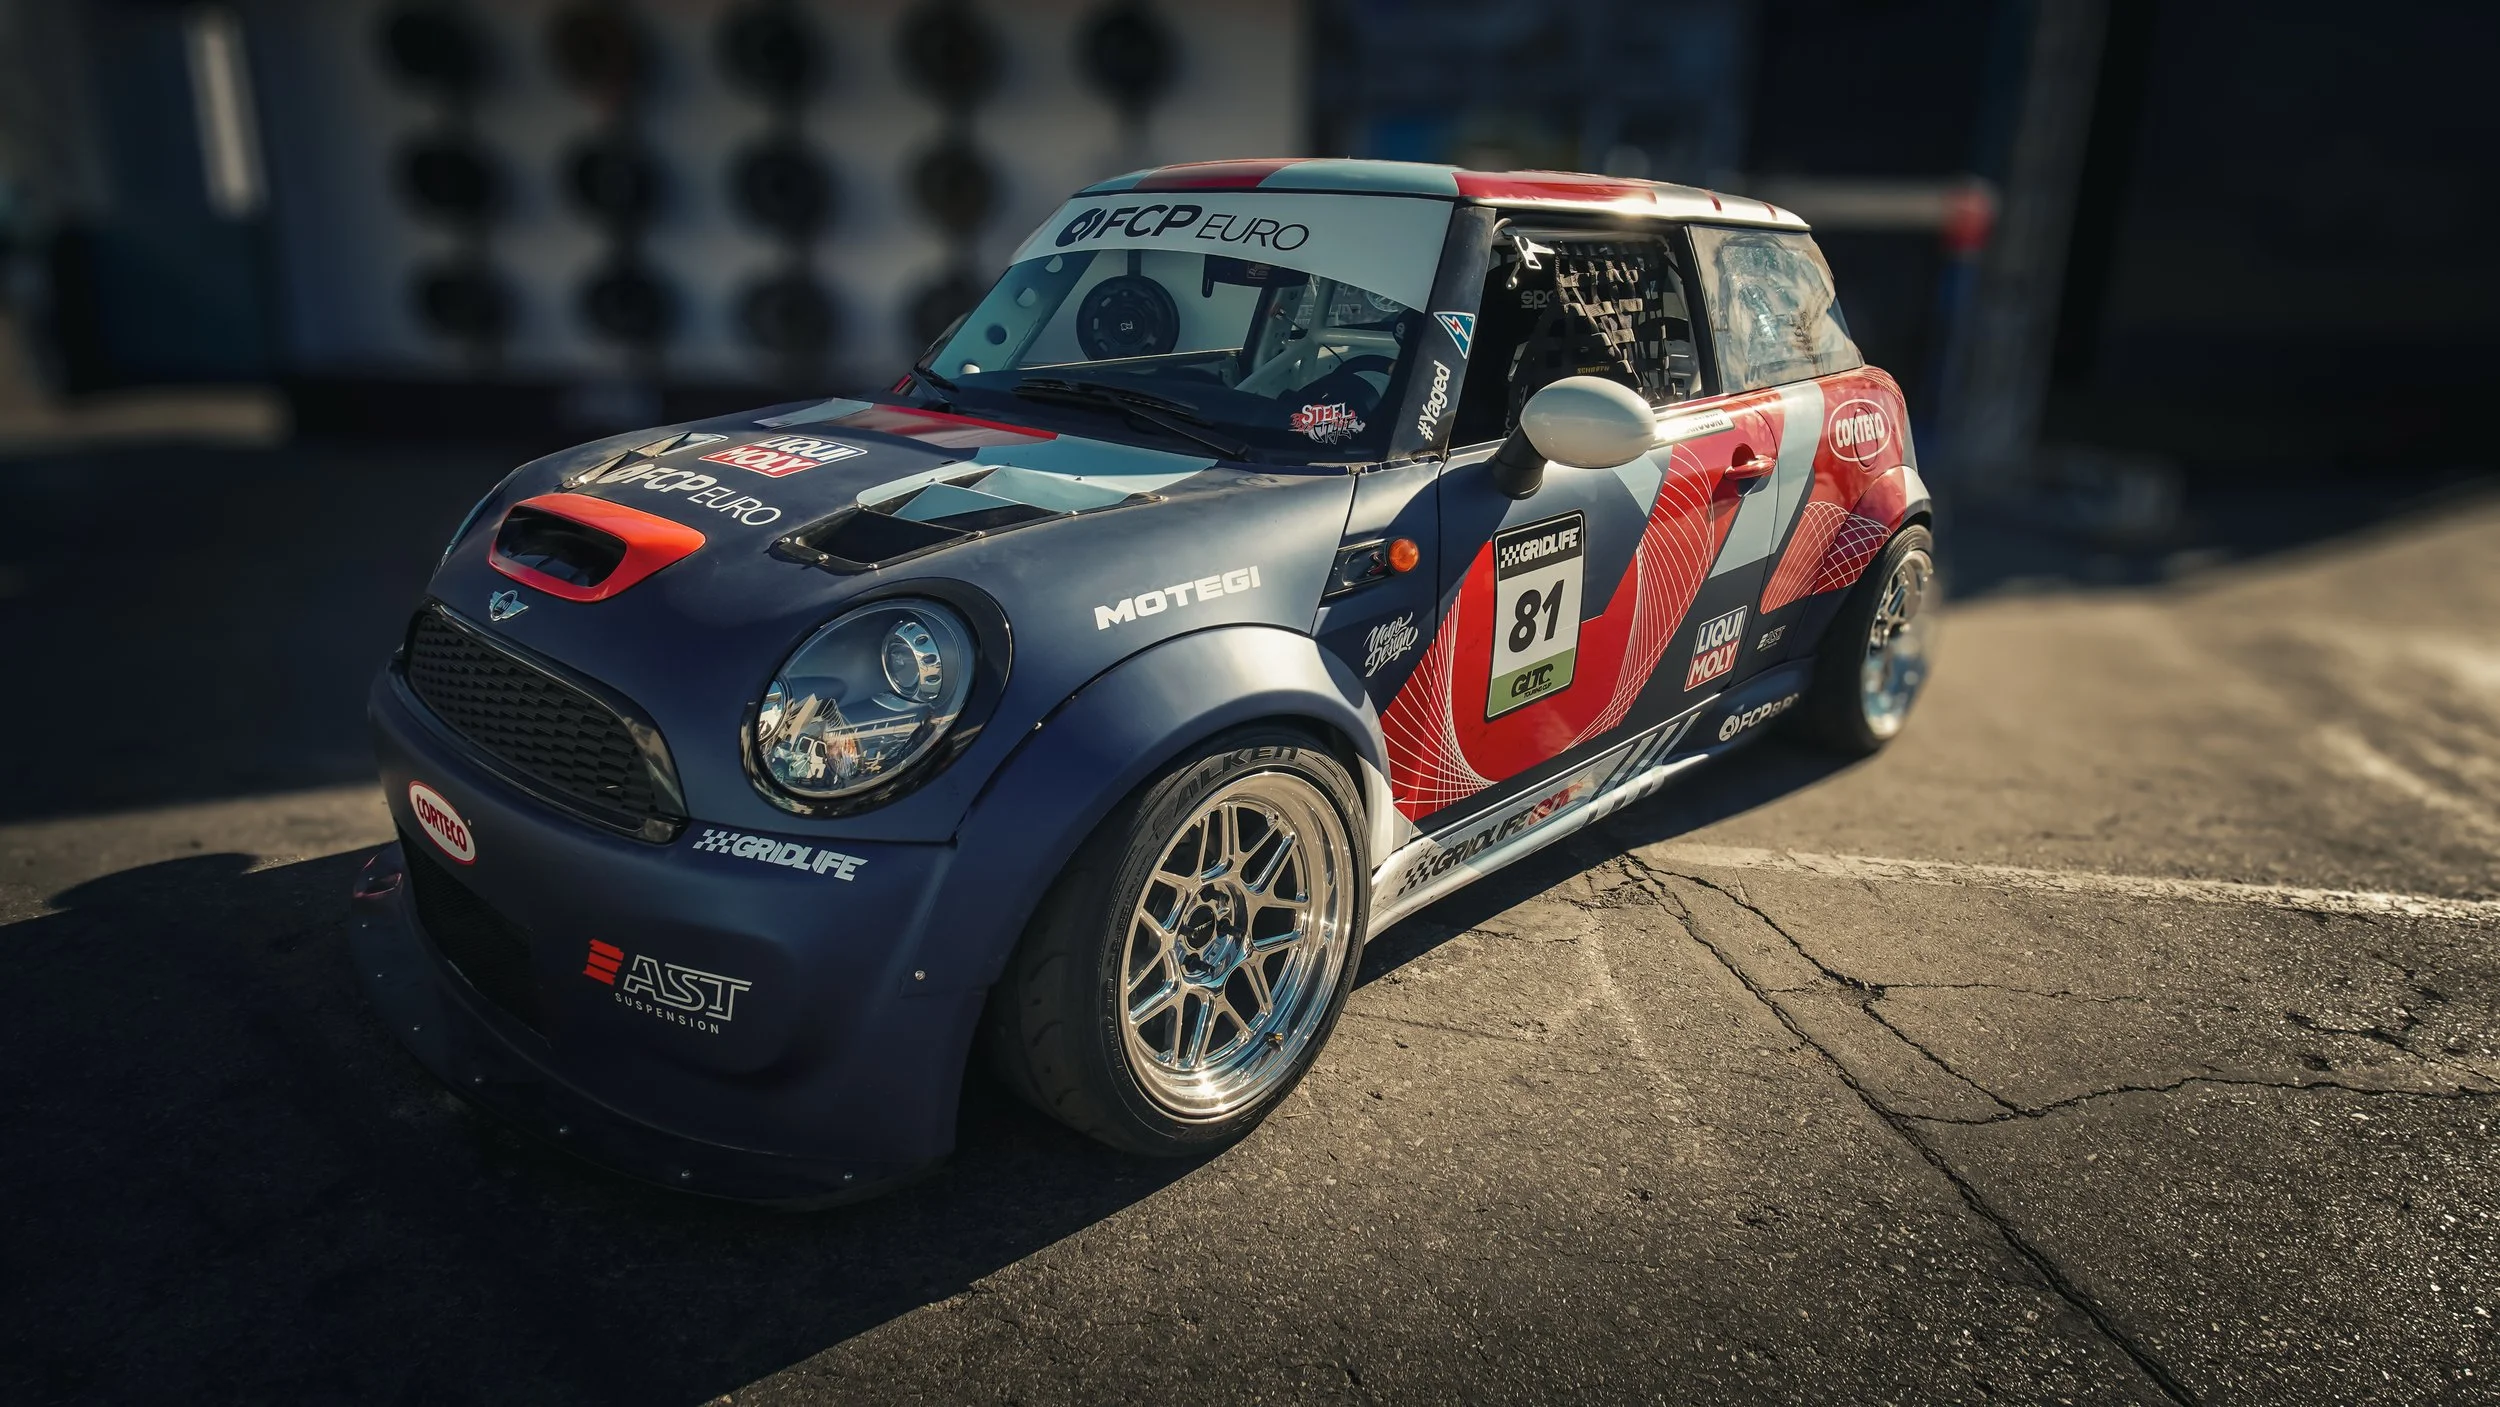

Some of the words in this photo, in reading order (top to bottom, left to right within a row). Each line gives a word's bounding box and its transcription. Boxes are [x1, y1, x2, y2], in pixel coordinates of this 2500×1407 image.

[1093, 204, 1202, 239] FCP
[1195, 213, 1310, 251] EURO
[1302, 402, 1353, 424] STEEL
[1417, 360, 1451, 442] #Yaged
[708, 447, 817, 473] MOLY
[754, 436, 858, 462] LIQUI
[621, 467, 718, 493] FCP
[686, 486, 782, 526] EURO
[1519, 527, 1580, 563] GRIDLIFE
[1094, 565, 1261, 631] MOTEGI
[1508, 579, 1565, 653] 81
[1696, 610, 1745, 655] LIQUI
[1511, 663, 1554, 698] GLTC
[1688, 641, 1739, 687] MOLY
[416, 793, 468, 853] CORTECO
[1432, 805, 1536, 877] GRIDLIFE
[731, 835, 869, 882] GRIDLIFE
[623, 954, 753, 1021] AST
[614, 992, 719, 1035] SUSPENSION
